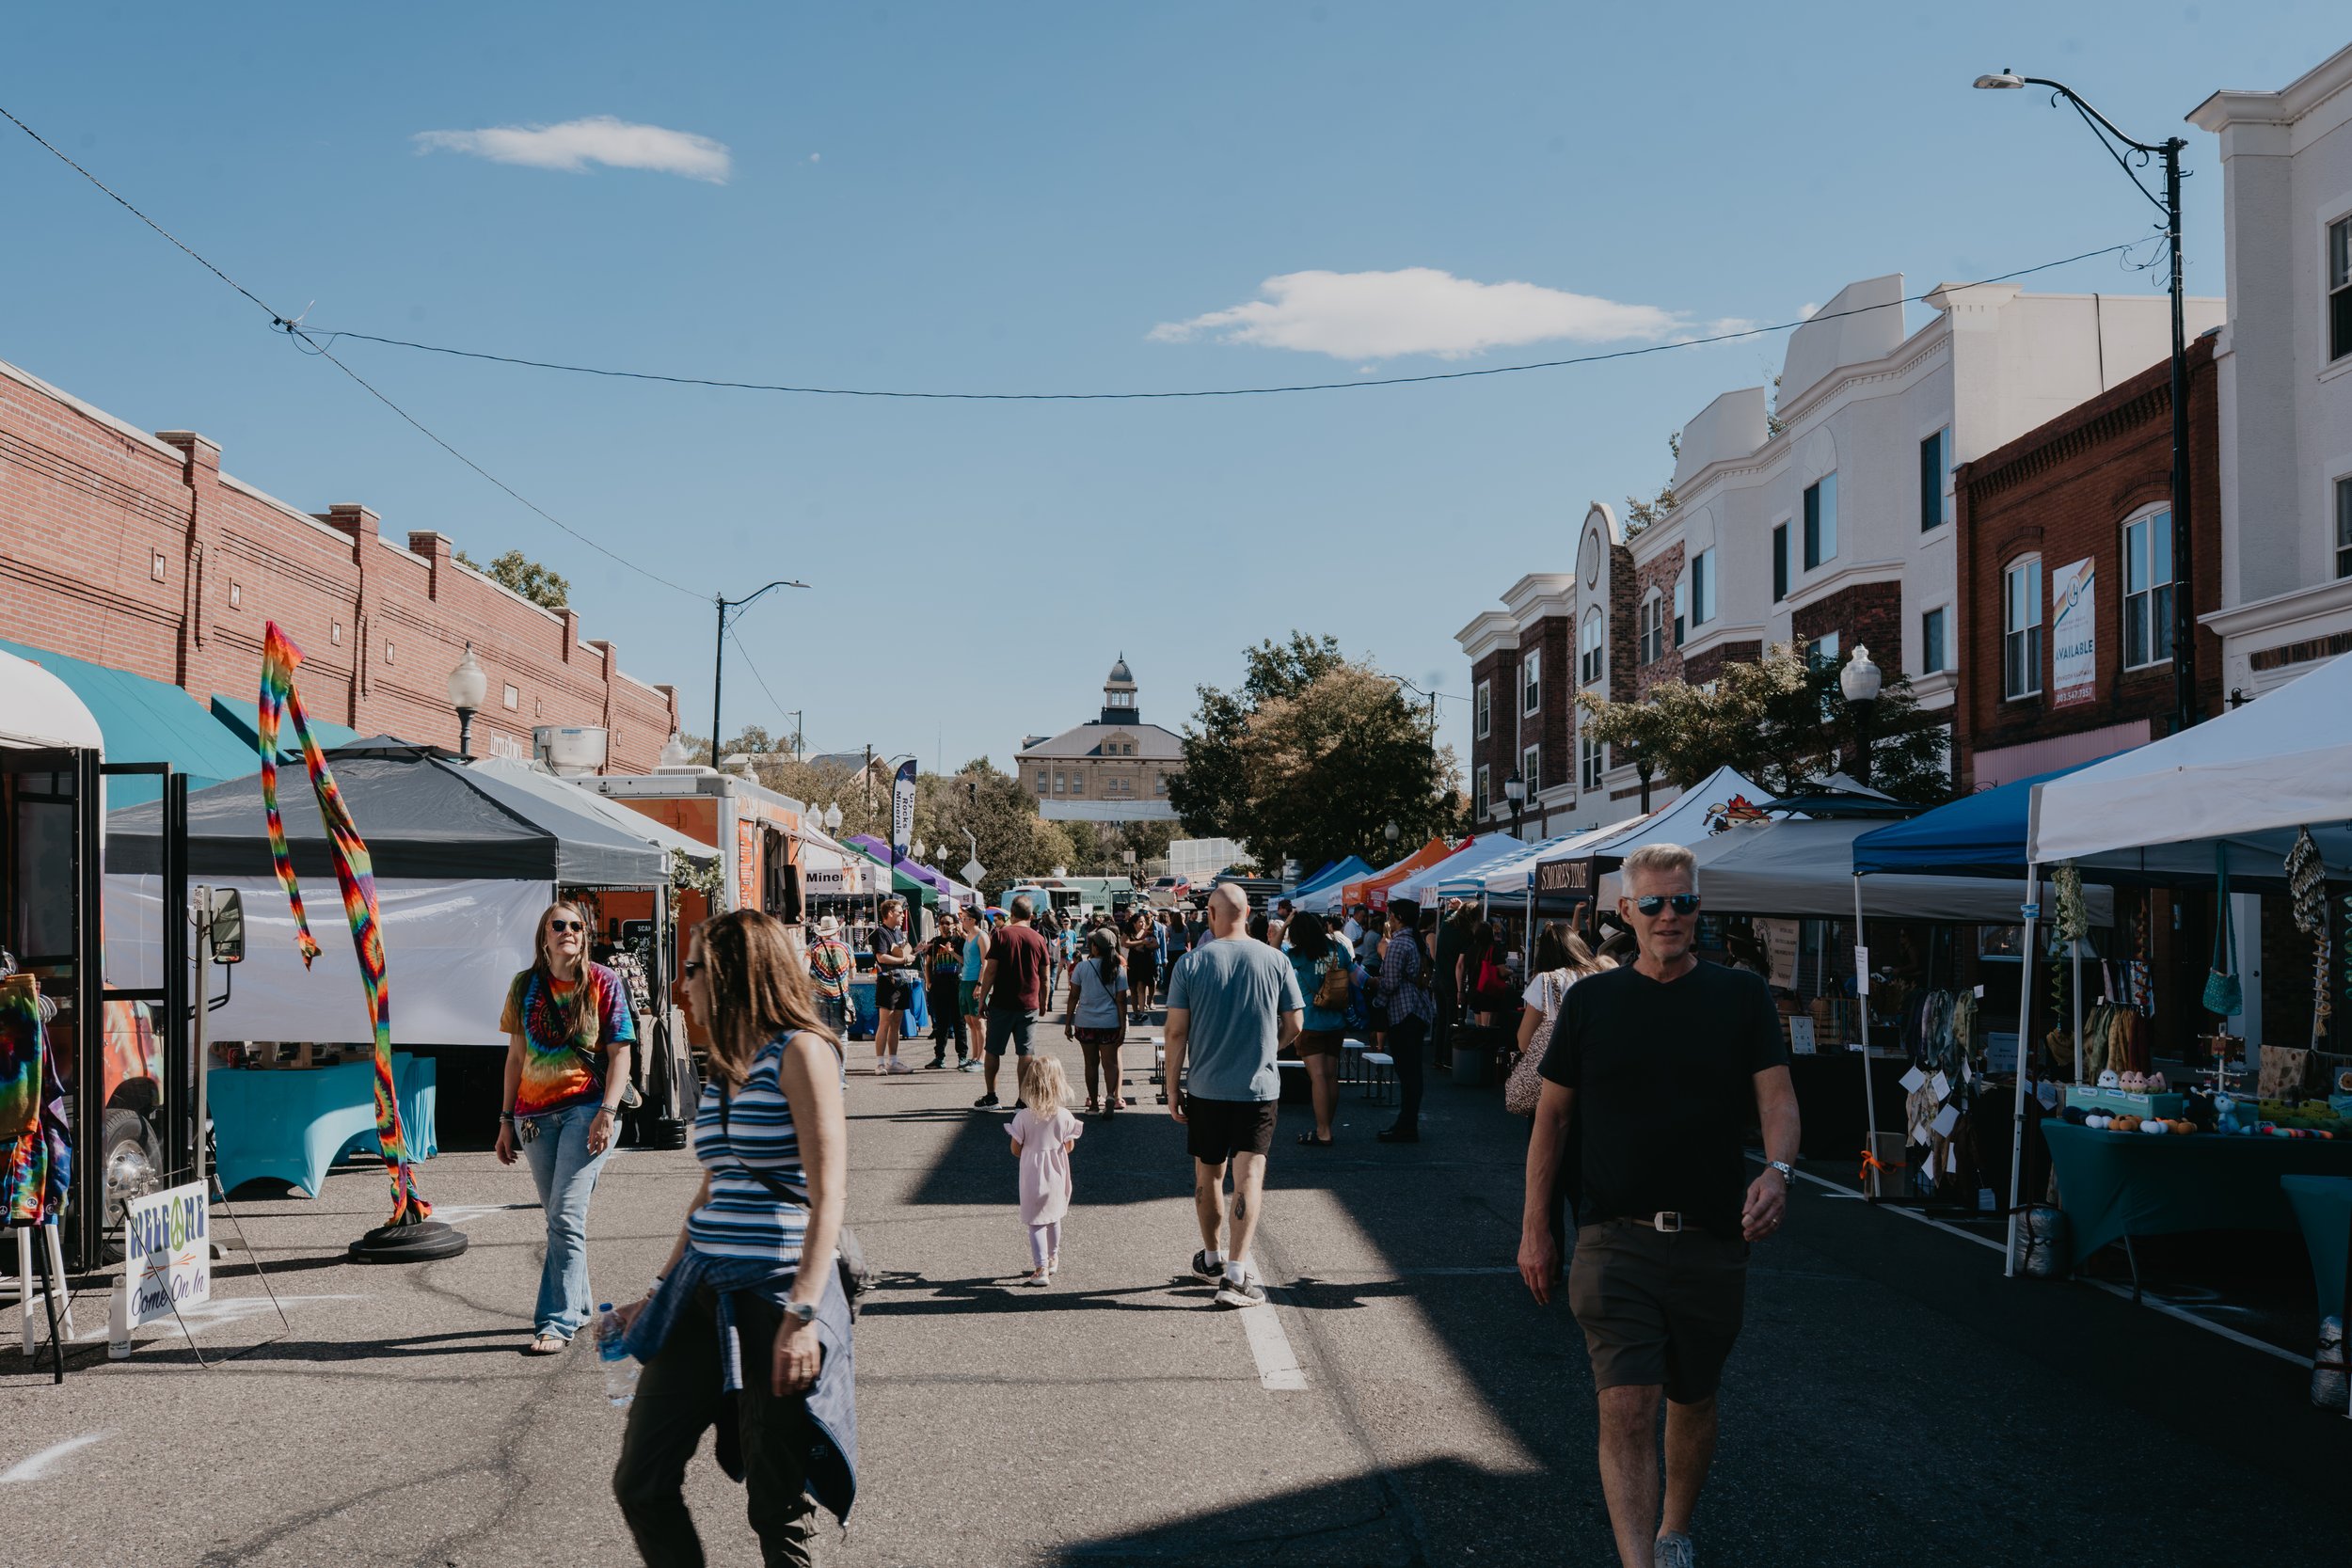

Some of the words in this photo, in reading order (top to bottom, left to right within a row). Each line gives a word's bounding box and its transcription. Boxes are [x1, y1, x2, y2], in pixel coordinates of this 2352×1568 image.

[2056, 640, 2093, 661] AVAILABLE
[806, 872, 867, 882] Miners
[1541, 863, 1570, 891] S'MORES
[1570, 863, 1587, 889] TIME
[130, 1194, 205, 1260] WELCOME
[131, 1287, 168, 1317] Come
[171, 1274, 190, 1303] On
[193, 1267, 205, 1298] In
